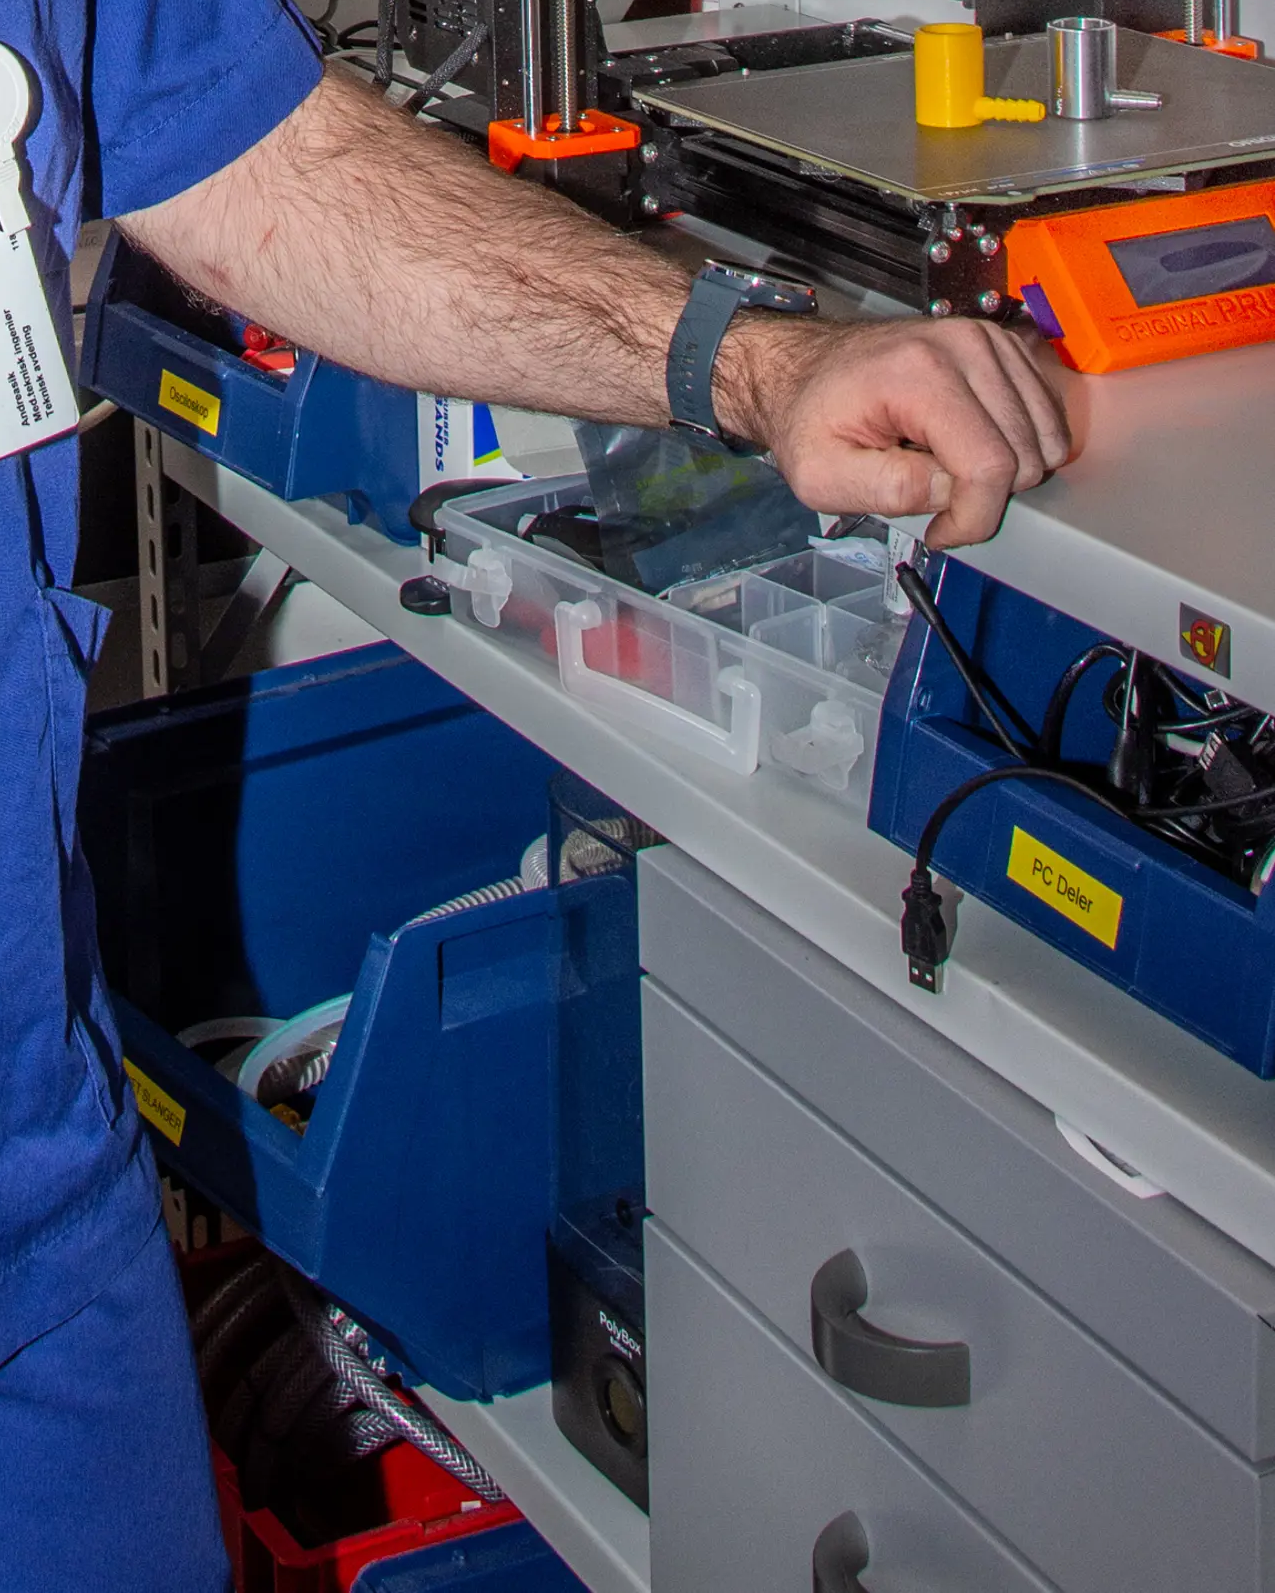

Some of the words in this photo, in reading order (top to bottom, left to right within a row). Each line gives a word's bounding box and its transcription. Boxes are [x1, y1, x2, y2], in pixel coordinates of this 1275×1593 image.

[3, 308, 23, 356] ingeniør
[22, 324, 42, 373] avdeling
[1115, 310, 1218, 343] ORIGINAL
[7, 371, 31, 427] Andreasik
[35, 373, 54, 419] Teknisk
[1032, 857, 1053, 886] PC
[1056, 873, 1093, 914] Deler
[600, 1310, 642, 1356] PolyBox
